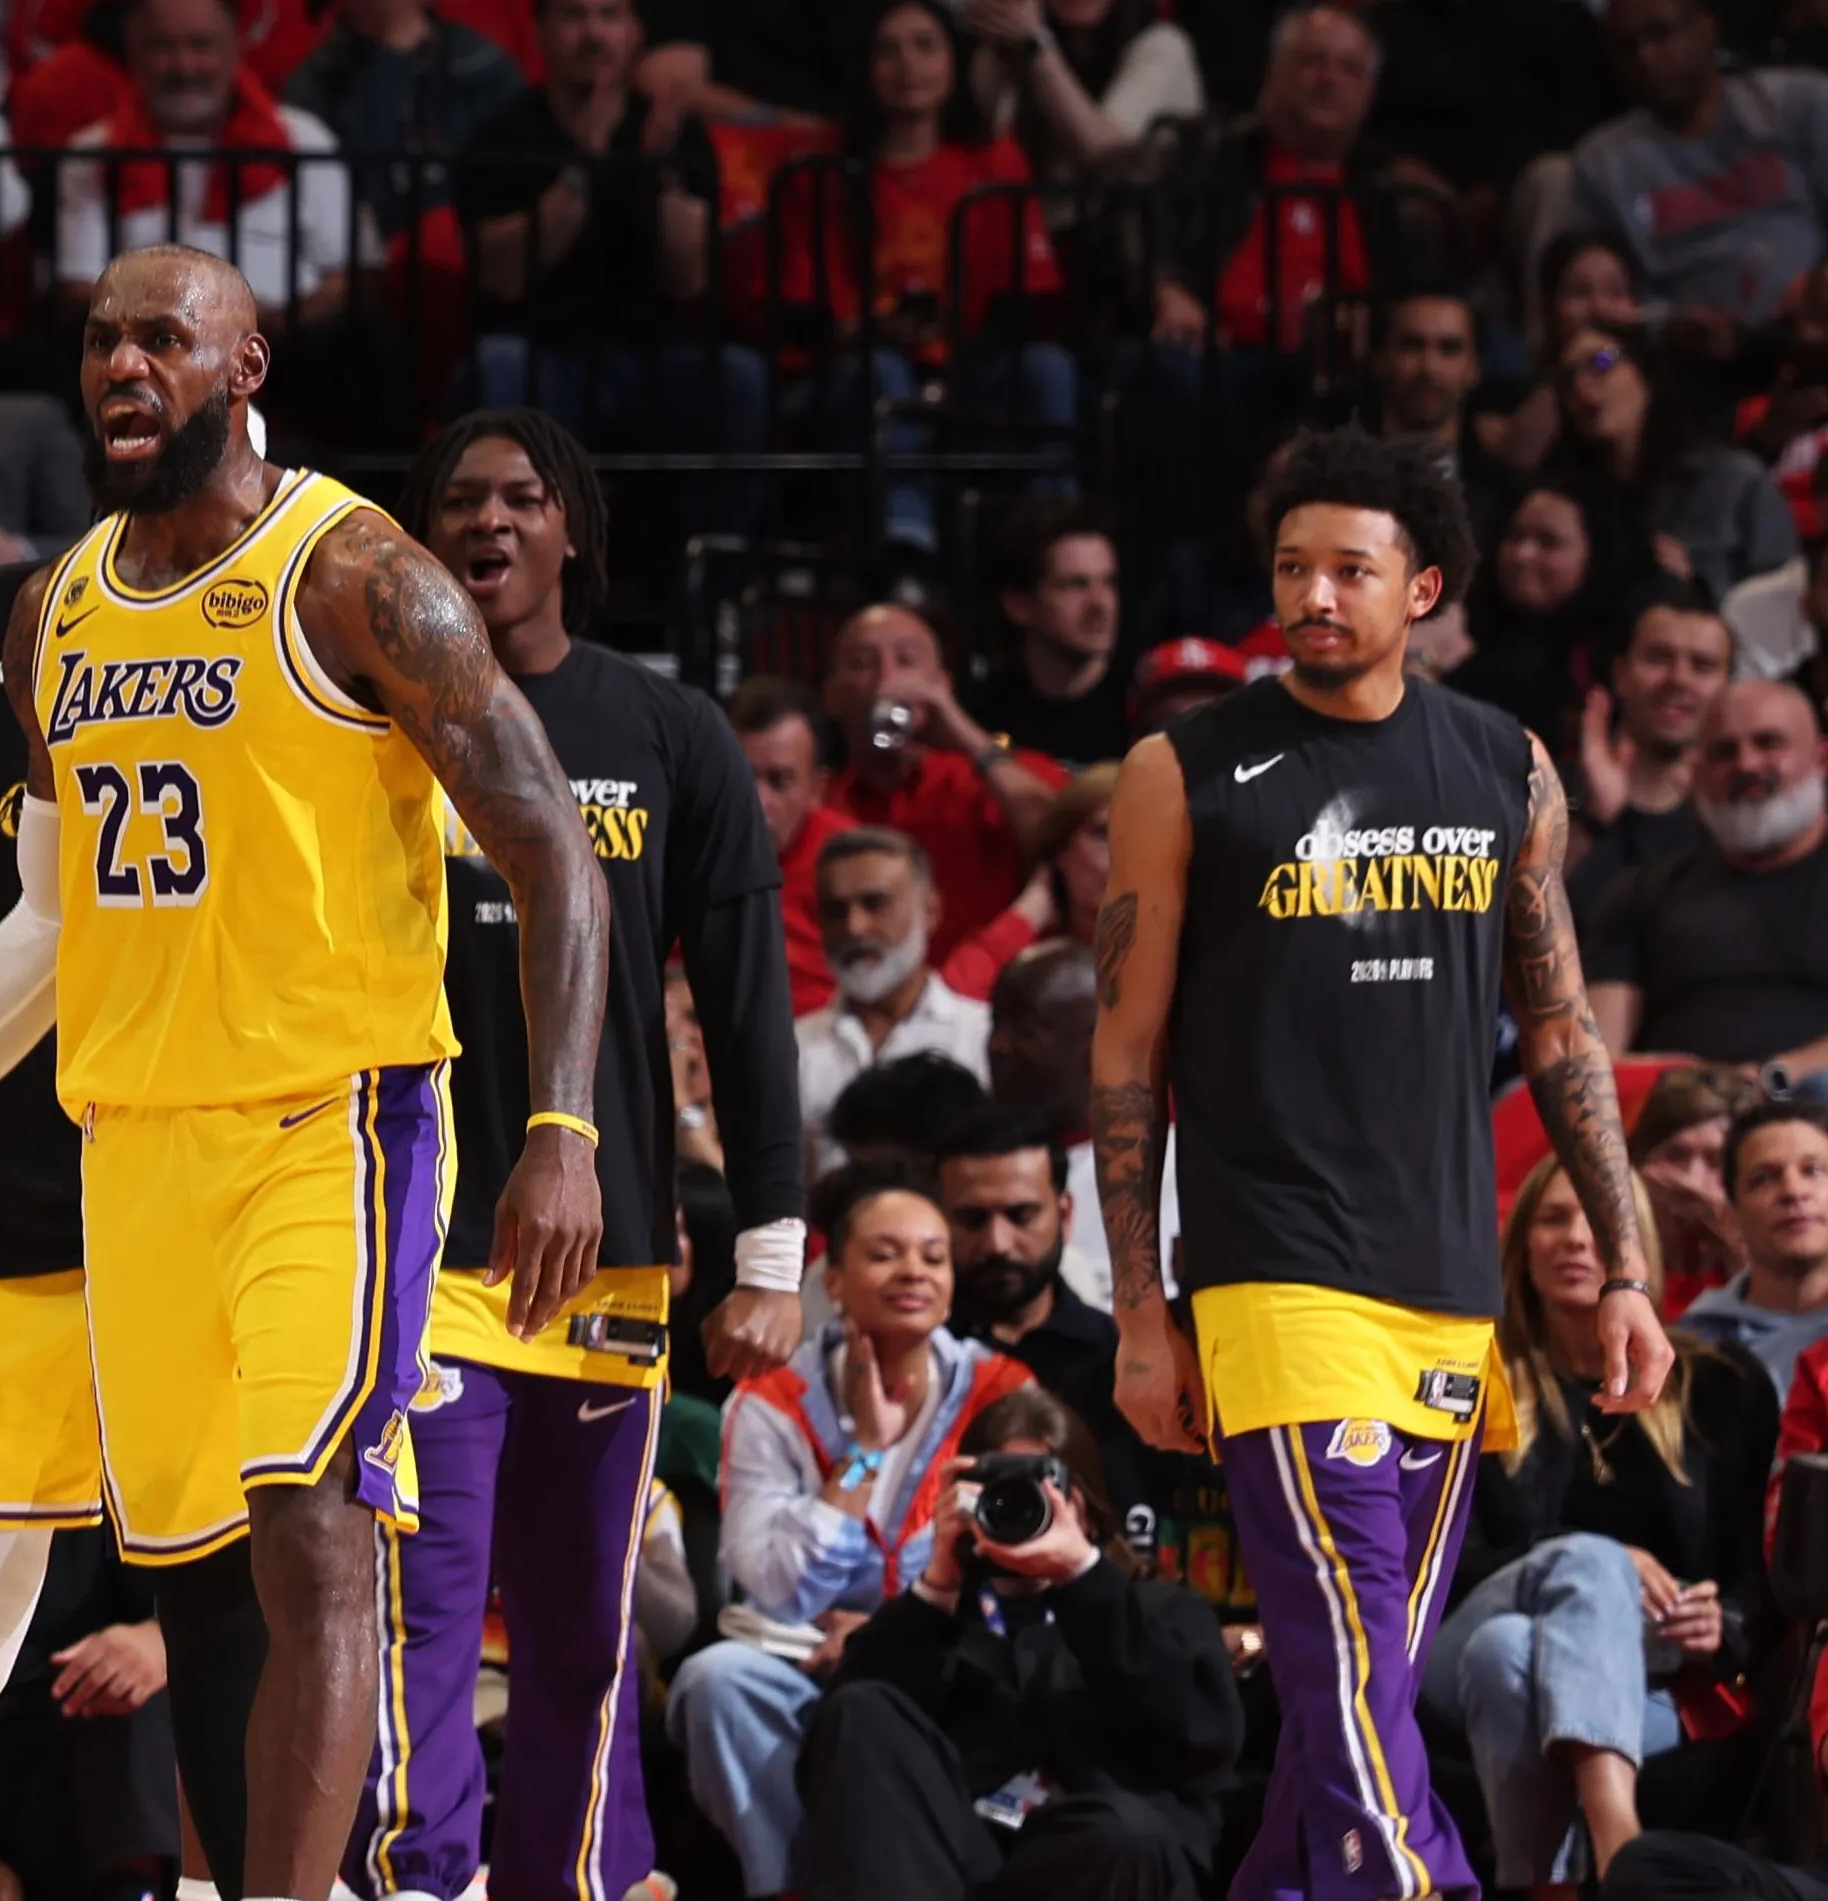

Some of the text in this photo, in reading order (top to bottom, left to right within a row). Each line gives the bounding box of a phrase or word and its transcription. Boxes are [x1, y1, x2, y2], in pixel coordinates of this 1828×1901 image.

[208, 591, 265, 615] bibigo
[47, 649, 244, 749] LAKERS
[72, 760, 209, 908] 23
[1295, 818, 1497, 861] obsess over
[1258, 854, 1500, 920] GREATNESS
